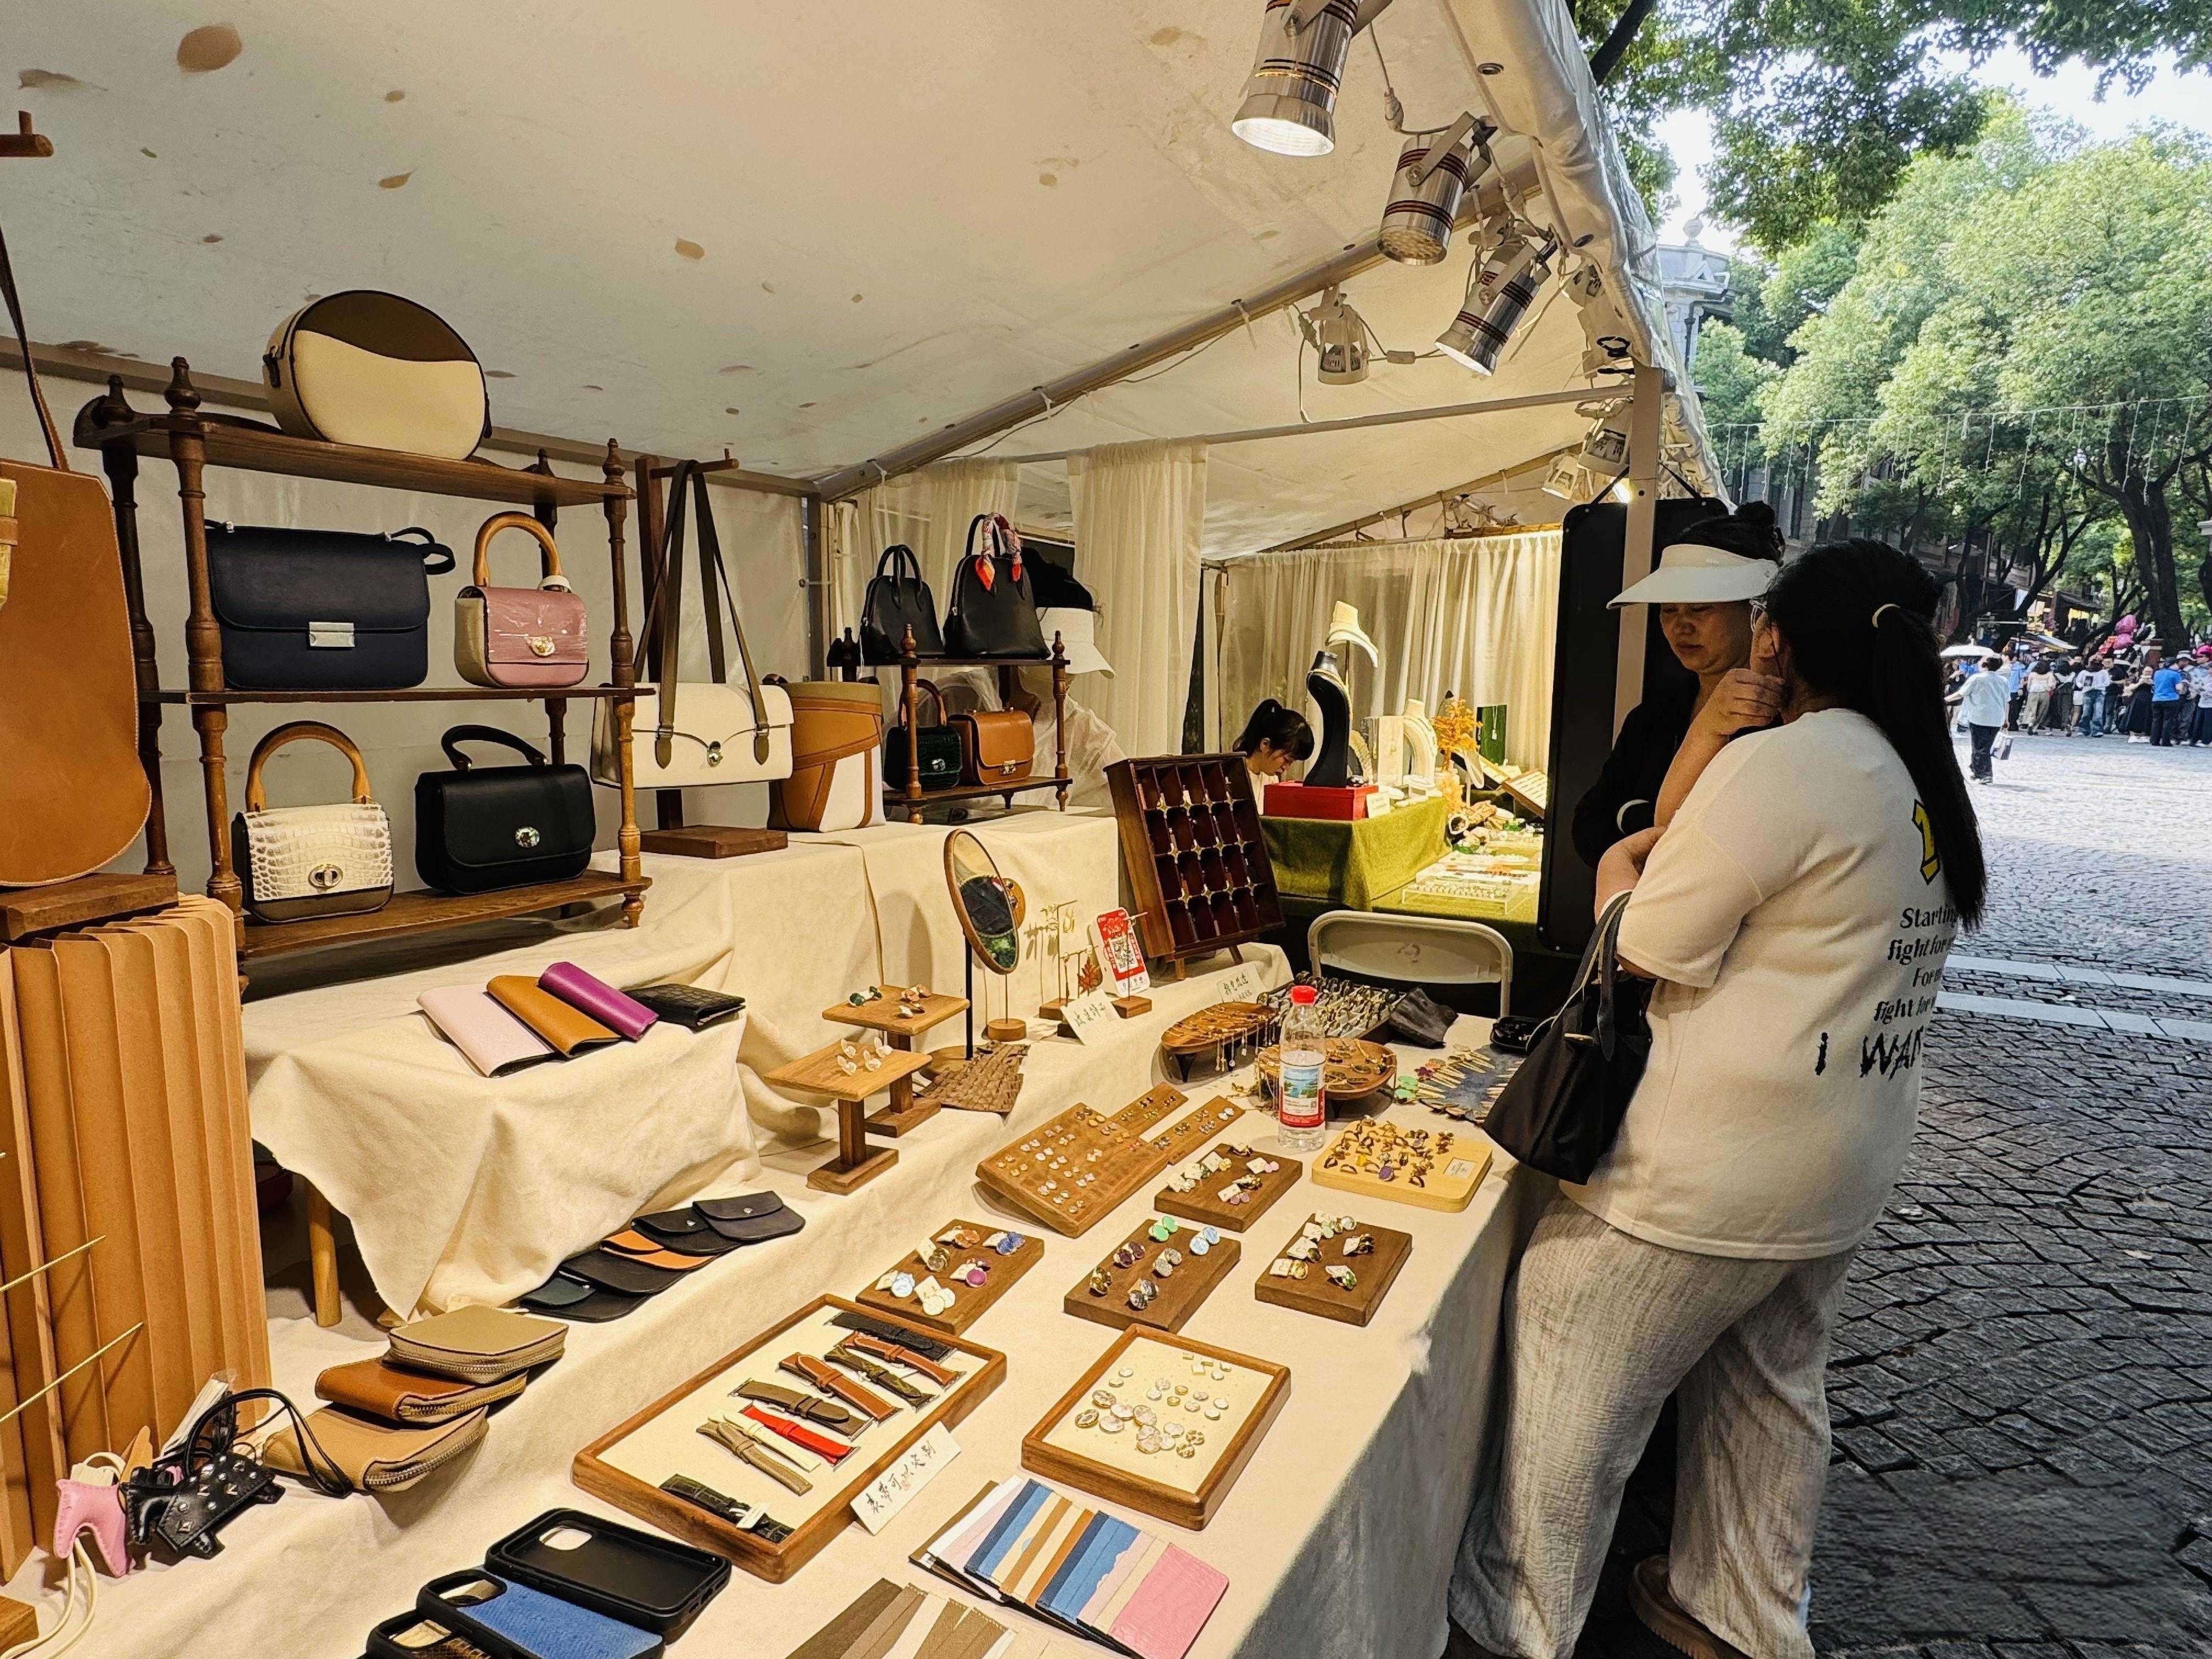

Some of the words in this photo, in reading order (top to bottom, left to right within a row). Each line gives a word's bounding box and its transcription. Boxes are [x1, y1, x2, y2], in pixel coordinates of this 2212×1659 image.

[1887, 939, 1930, 965] fight
[1929, 935, 1947, 955] for
[1874, 998, 1913, 1024] fight
